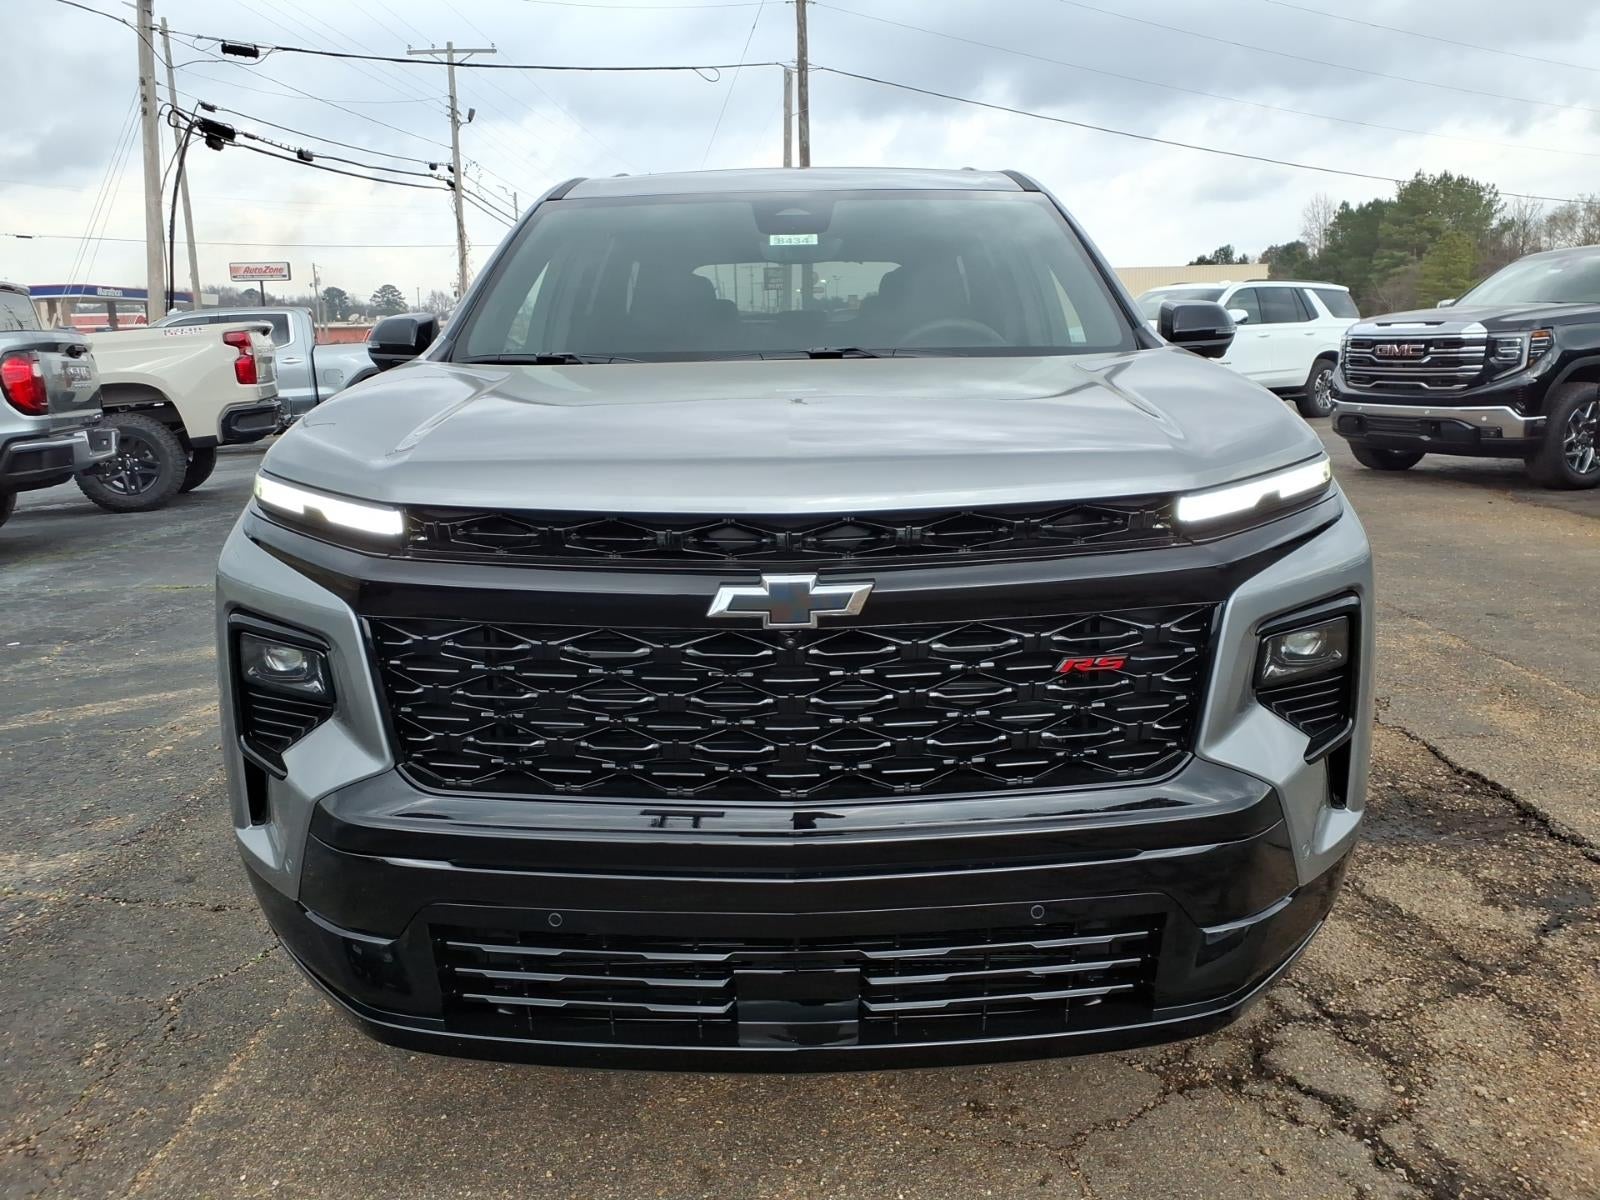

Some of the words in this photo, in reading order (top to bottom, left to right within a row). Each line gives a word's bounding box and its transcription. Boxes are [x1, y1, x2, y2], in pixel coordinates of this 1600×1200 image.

[243, 265, 284, 274] AutoZone
[97, 287, 123, 296] Marathon
[1375, 344, 1425, 356] GMC
[1055, 656, 1128, 673] RS
